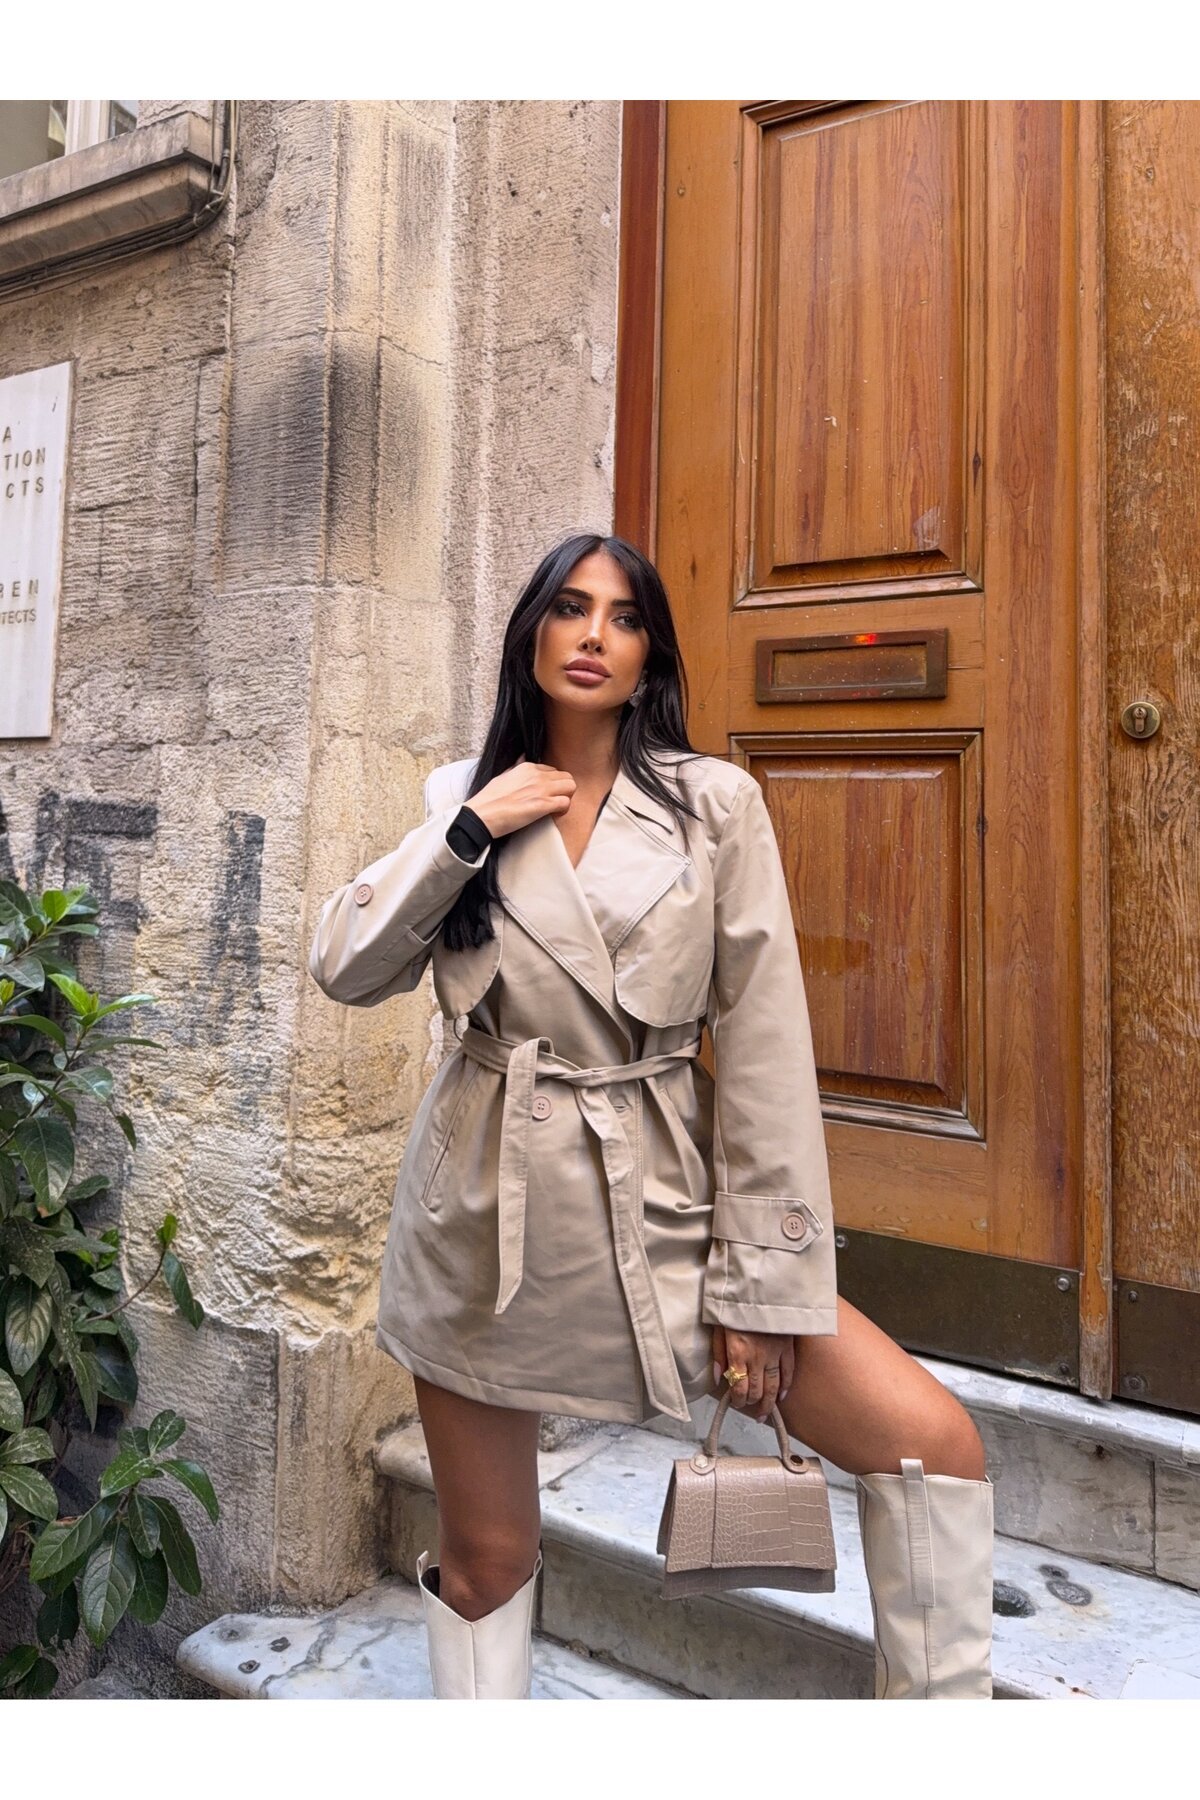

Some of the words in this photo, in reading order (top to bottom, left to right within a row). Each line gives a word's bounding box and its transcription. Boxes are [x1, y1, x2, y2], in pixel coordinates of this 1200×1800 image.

[3, 426, 12, 443] A
[4, 447, 46, 471] TION
[6, 476, 44, 499] CTS
